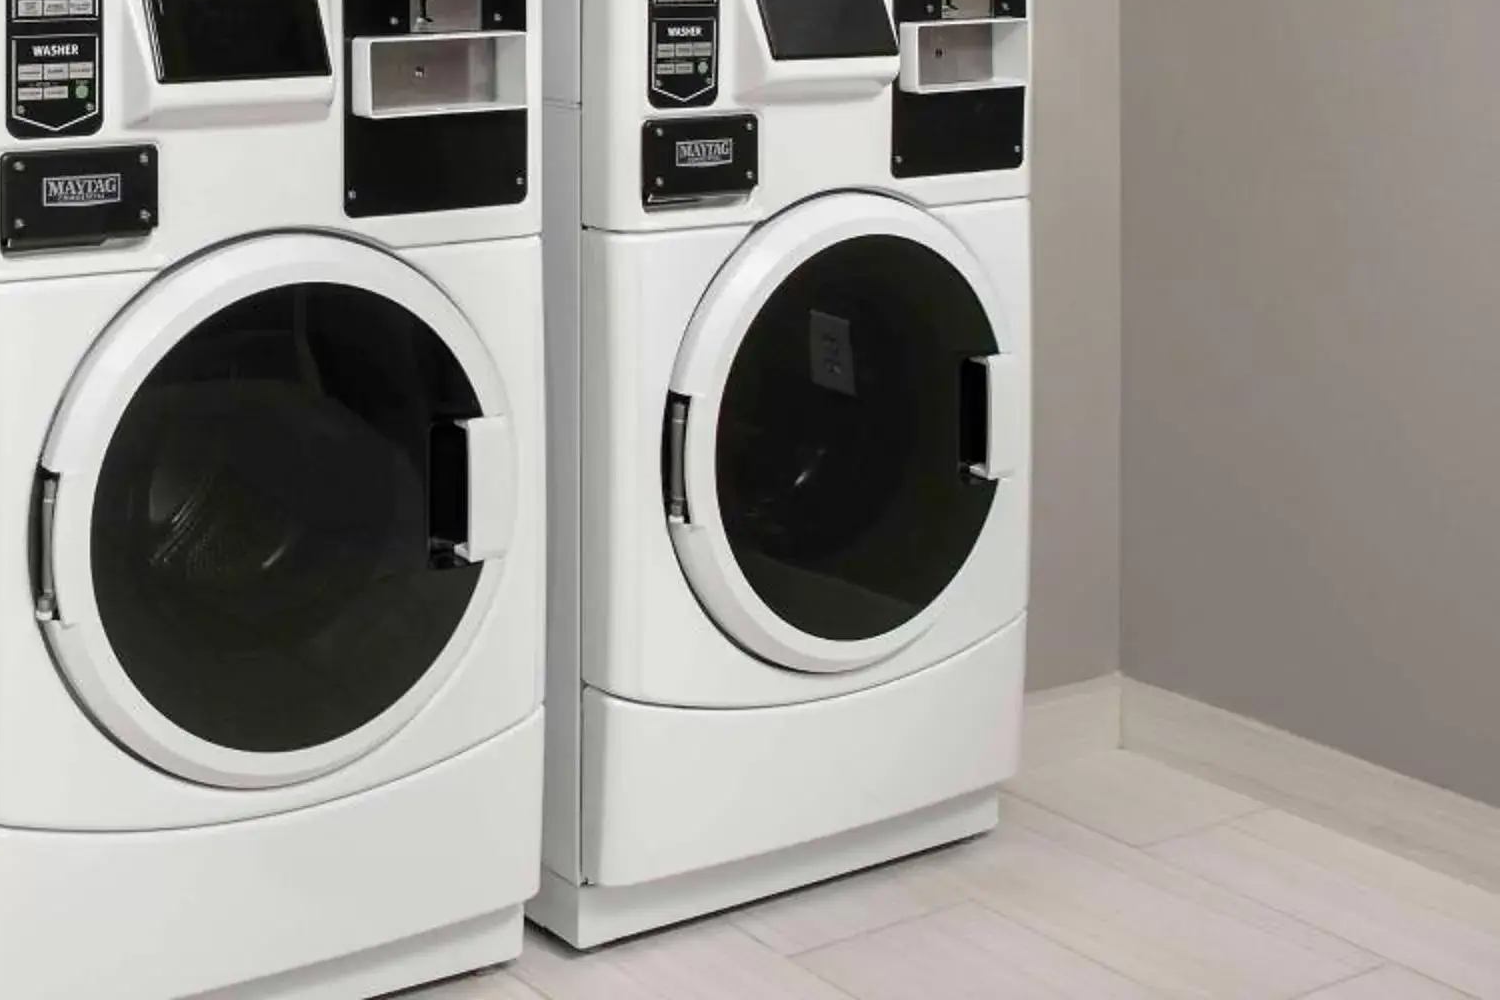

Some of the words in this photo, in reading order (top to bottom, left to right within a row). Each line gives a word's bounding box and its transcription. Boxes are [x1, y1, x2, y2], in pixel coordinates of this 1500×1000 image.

[667, 26, 703, 37] WASHER
[32, 44, 79, 57] WASHER
[679, 142, 729, 158] MAYTAG
[47, 177, 117, 197] MAYTAG
